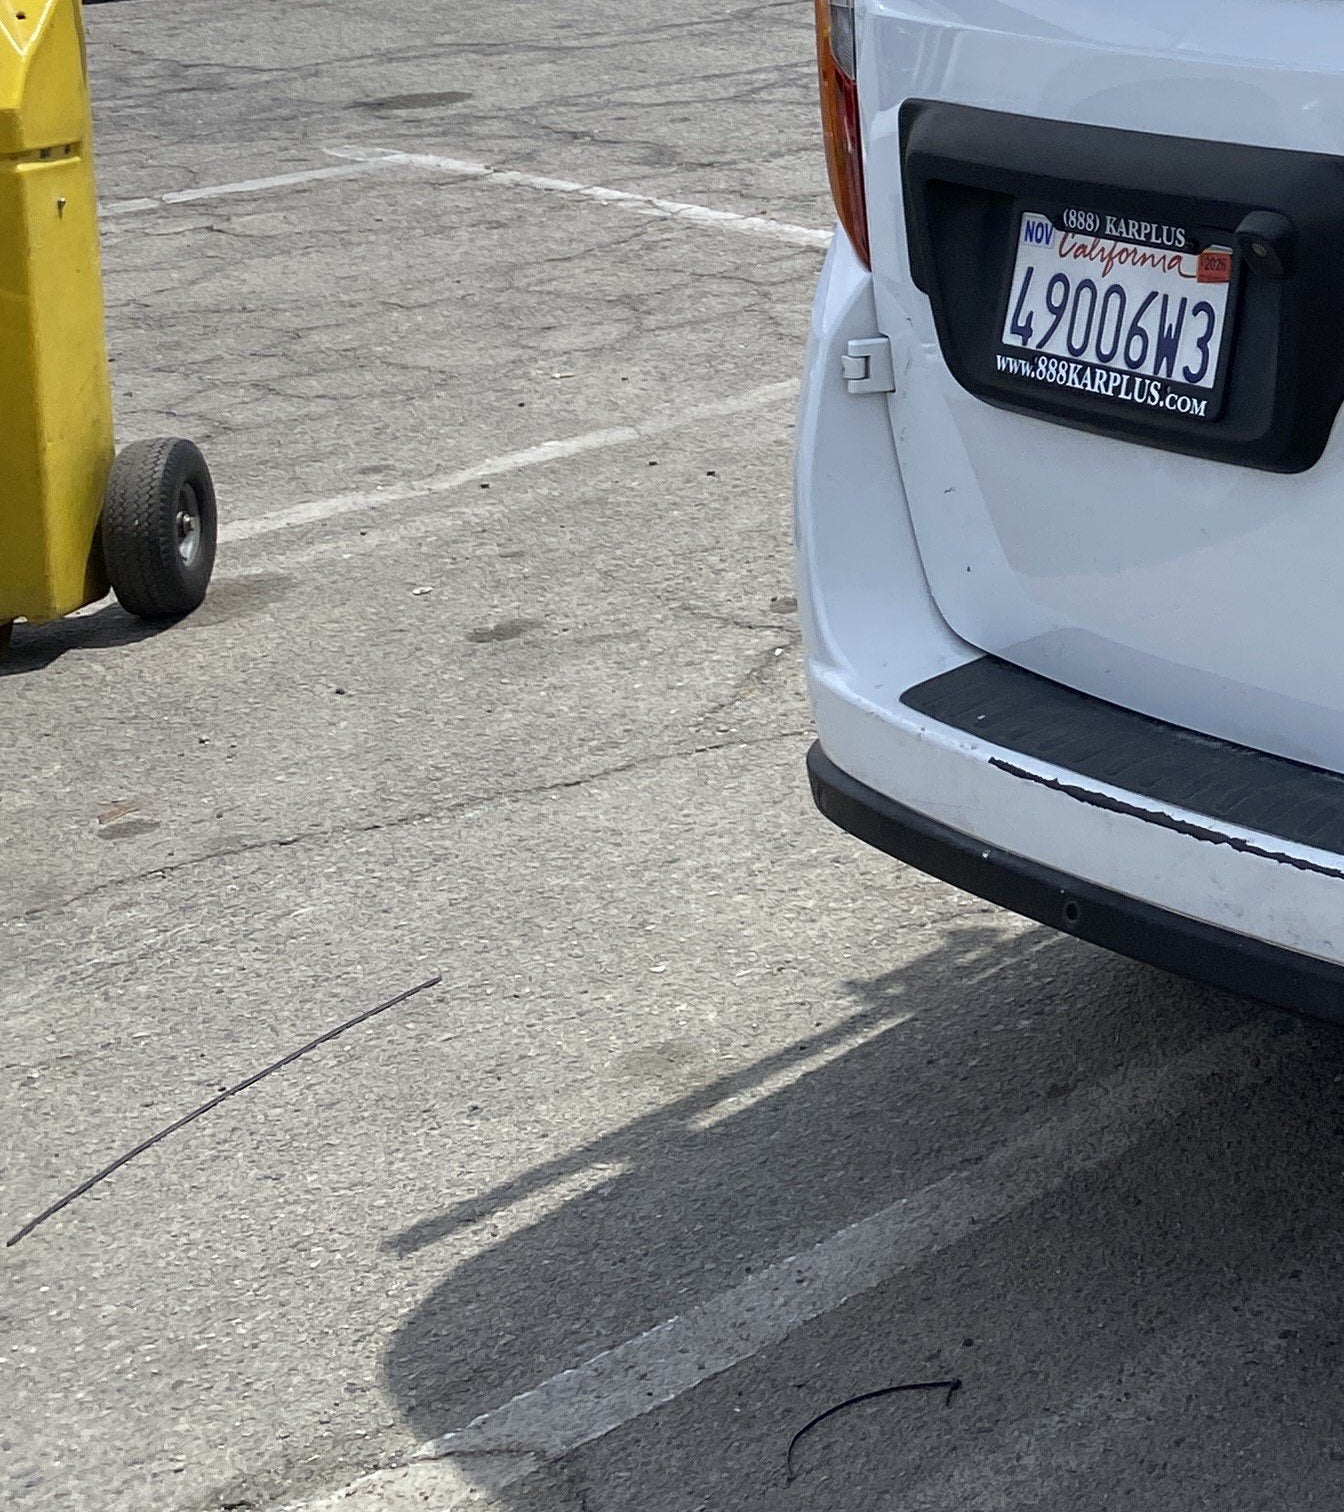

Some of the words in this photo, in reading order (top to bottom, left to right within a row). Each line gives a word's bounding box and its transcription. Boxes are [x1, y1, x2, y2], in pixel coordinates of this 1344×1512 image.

[1024, 220, 1053, 246] NOV
[1063, 208, 1100, 232] (888)
[1104, 216, 1186, 248] KARPLUS
[1058, 232, 1198, 278] California
[1010, 266, 1216, 384] 49006W3
